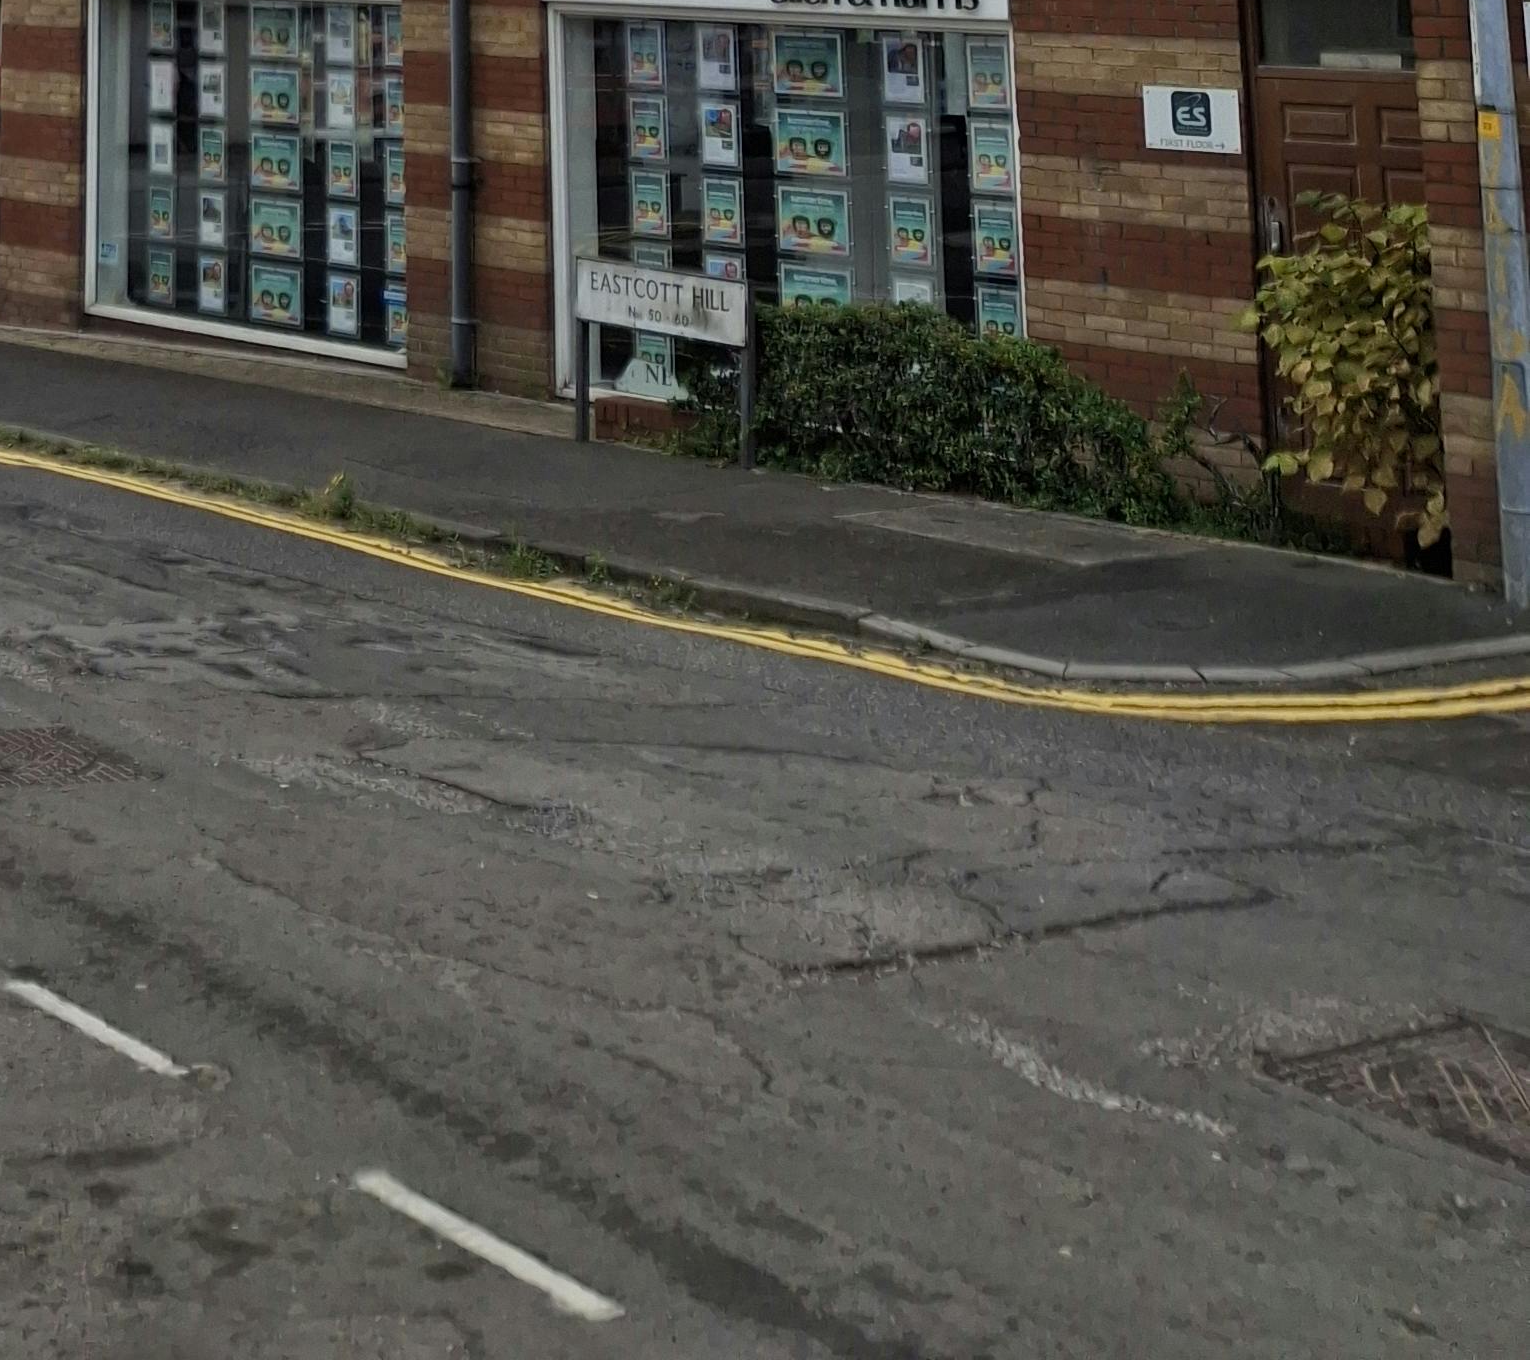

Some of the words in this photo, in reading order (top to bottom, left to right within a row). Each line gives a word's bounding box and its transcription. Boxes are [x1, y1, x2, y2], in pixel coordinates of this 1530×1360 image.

[1176, 106, 1207, 126] ES
[590, 271, 684, 305] EASTCOTT
[692, 286, 731, 313] HILL
